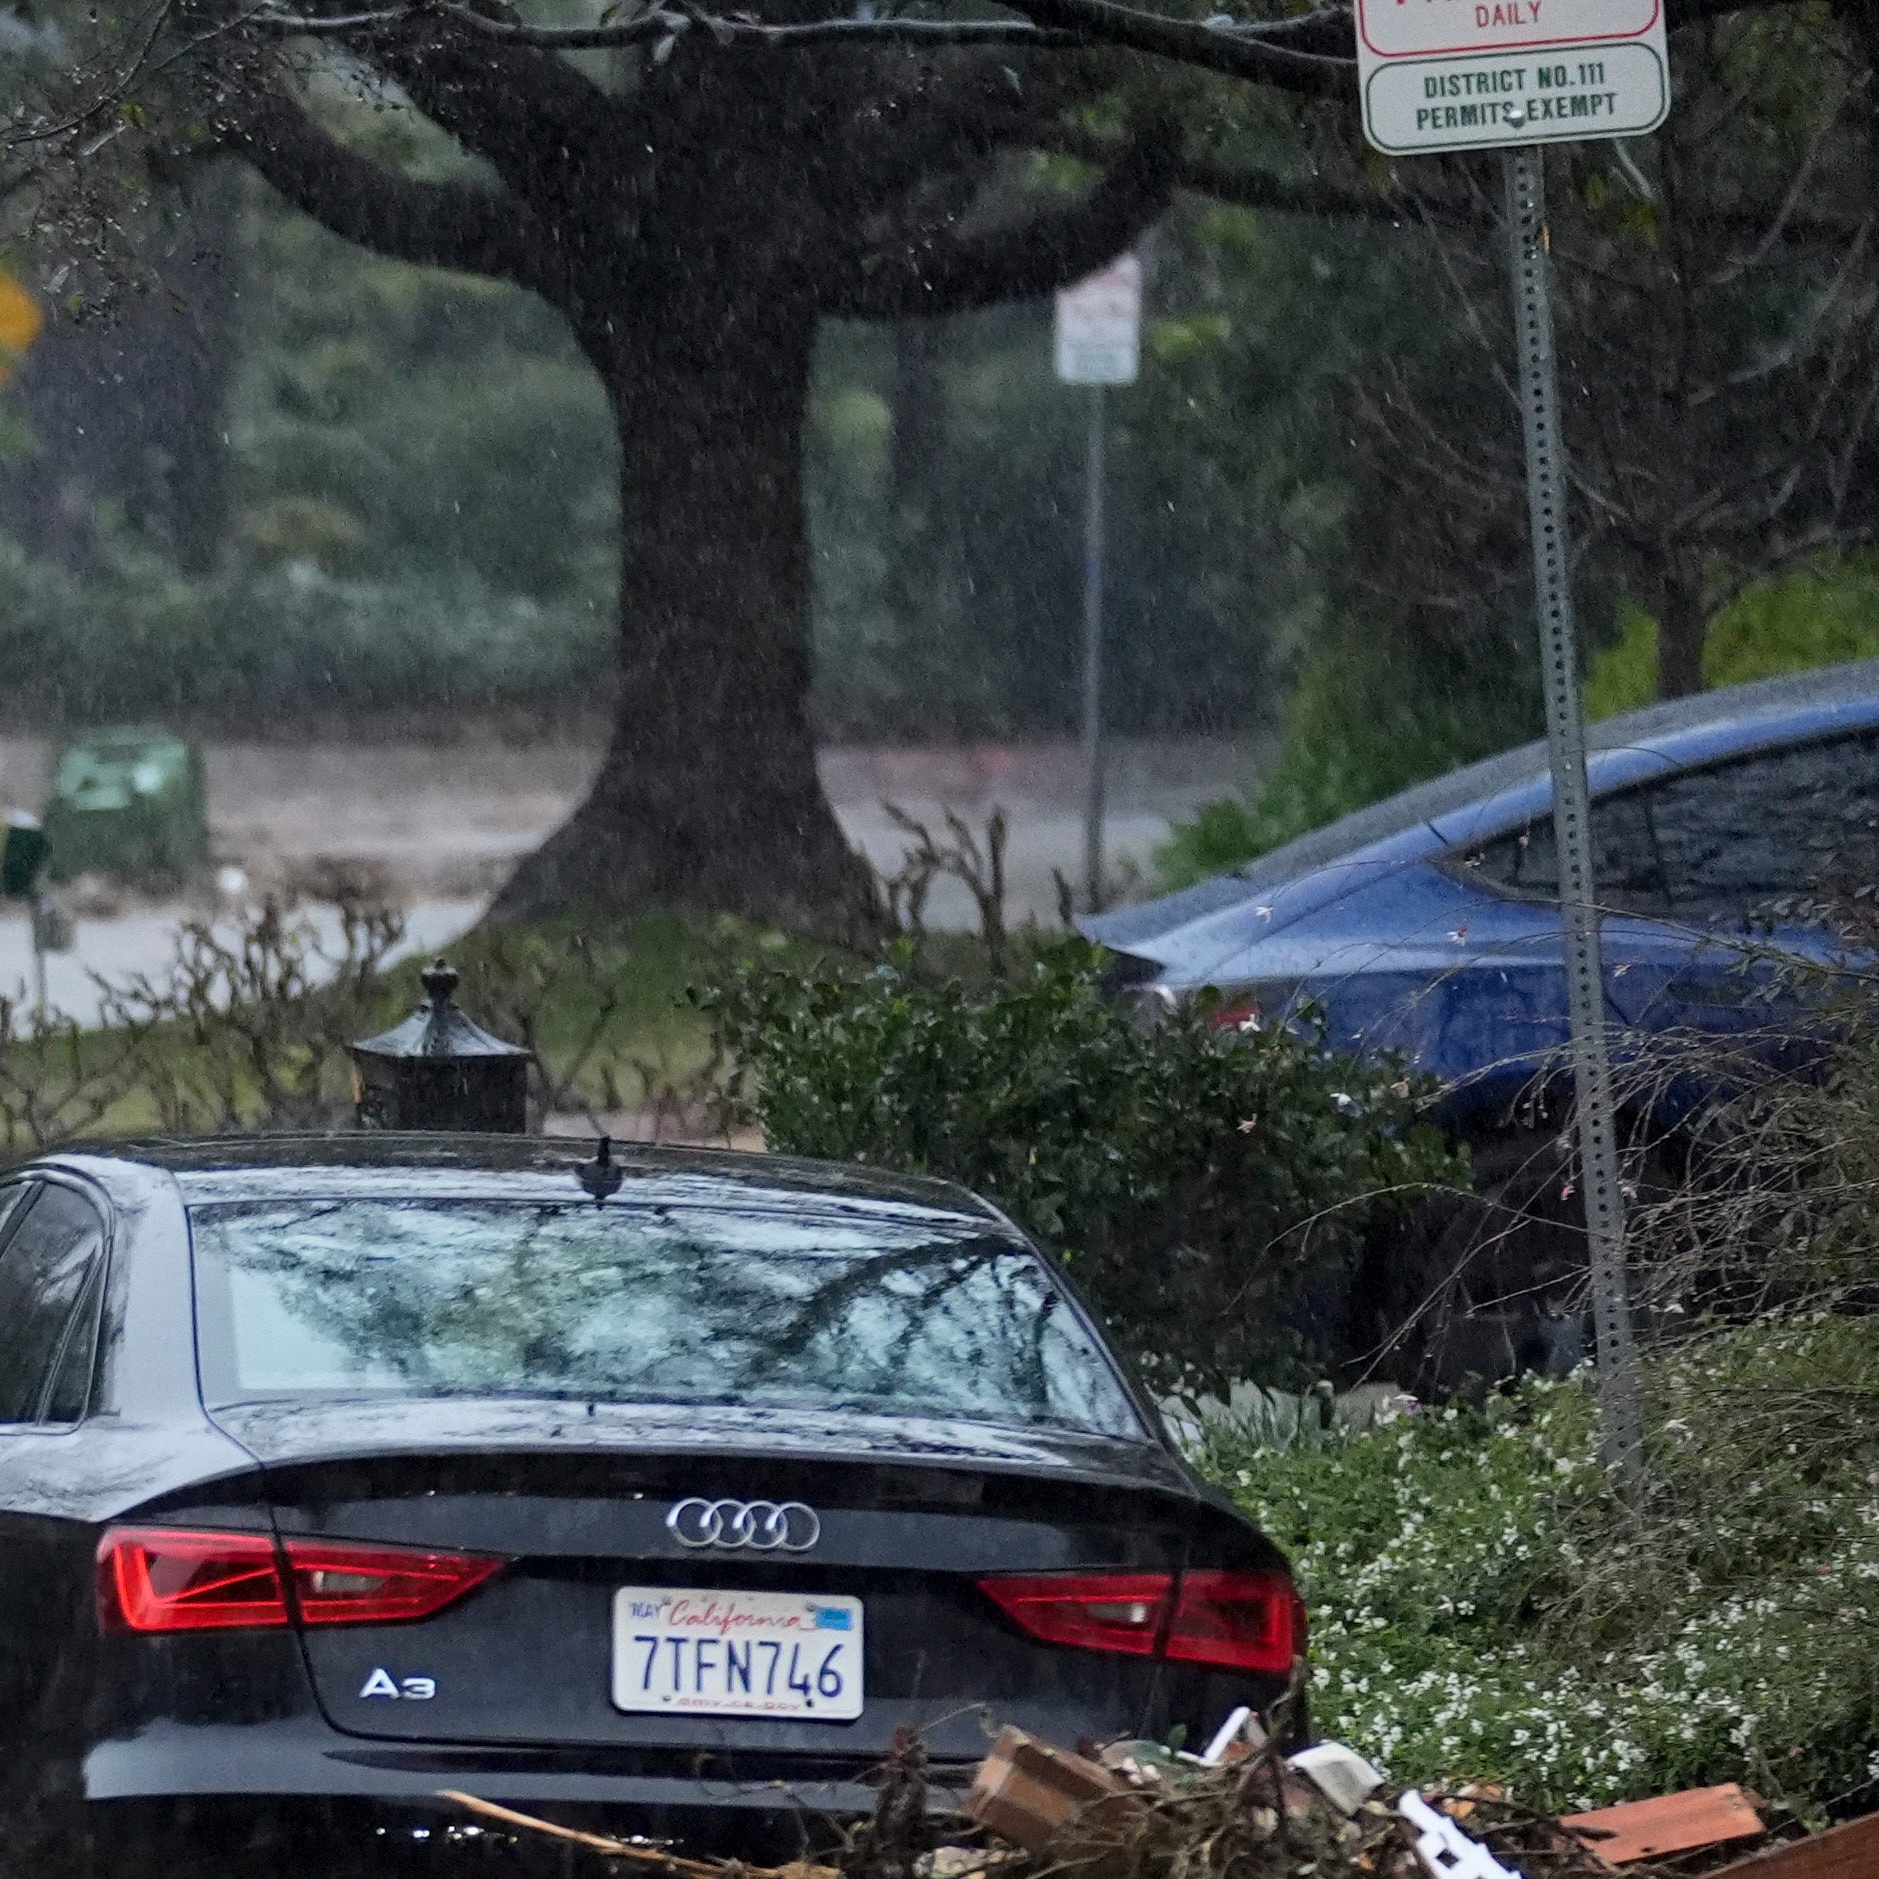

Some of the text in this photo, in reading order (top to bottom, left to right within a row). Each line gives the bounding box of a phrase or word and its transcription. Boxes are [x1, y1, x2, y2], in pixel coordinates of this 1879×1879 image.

[1475, 2, 1540, 28] DAILY
[1424, 68, 1527, 99] DISTRICT
[1527, 92, 1618, 122] EXEMPT
[669, 1598, 812, 1636] California
[634, 1635, 844, 1698] 7TFN746
[359, 1668, 436, 1700] A3
